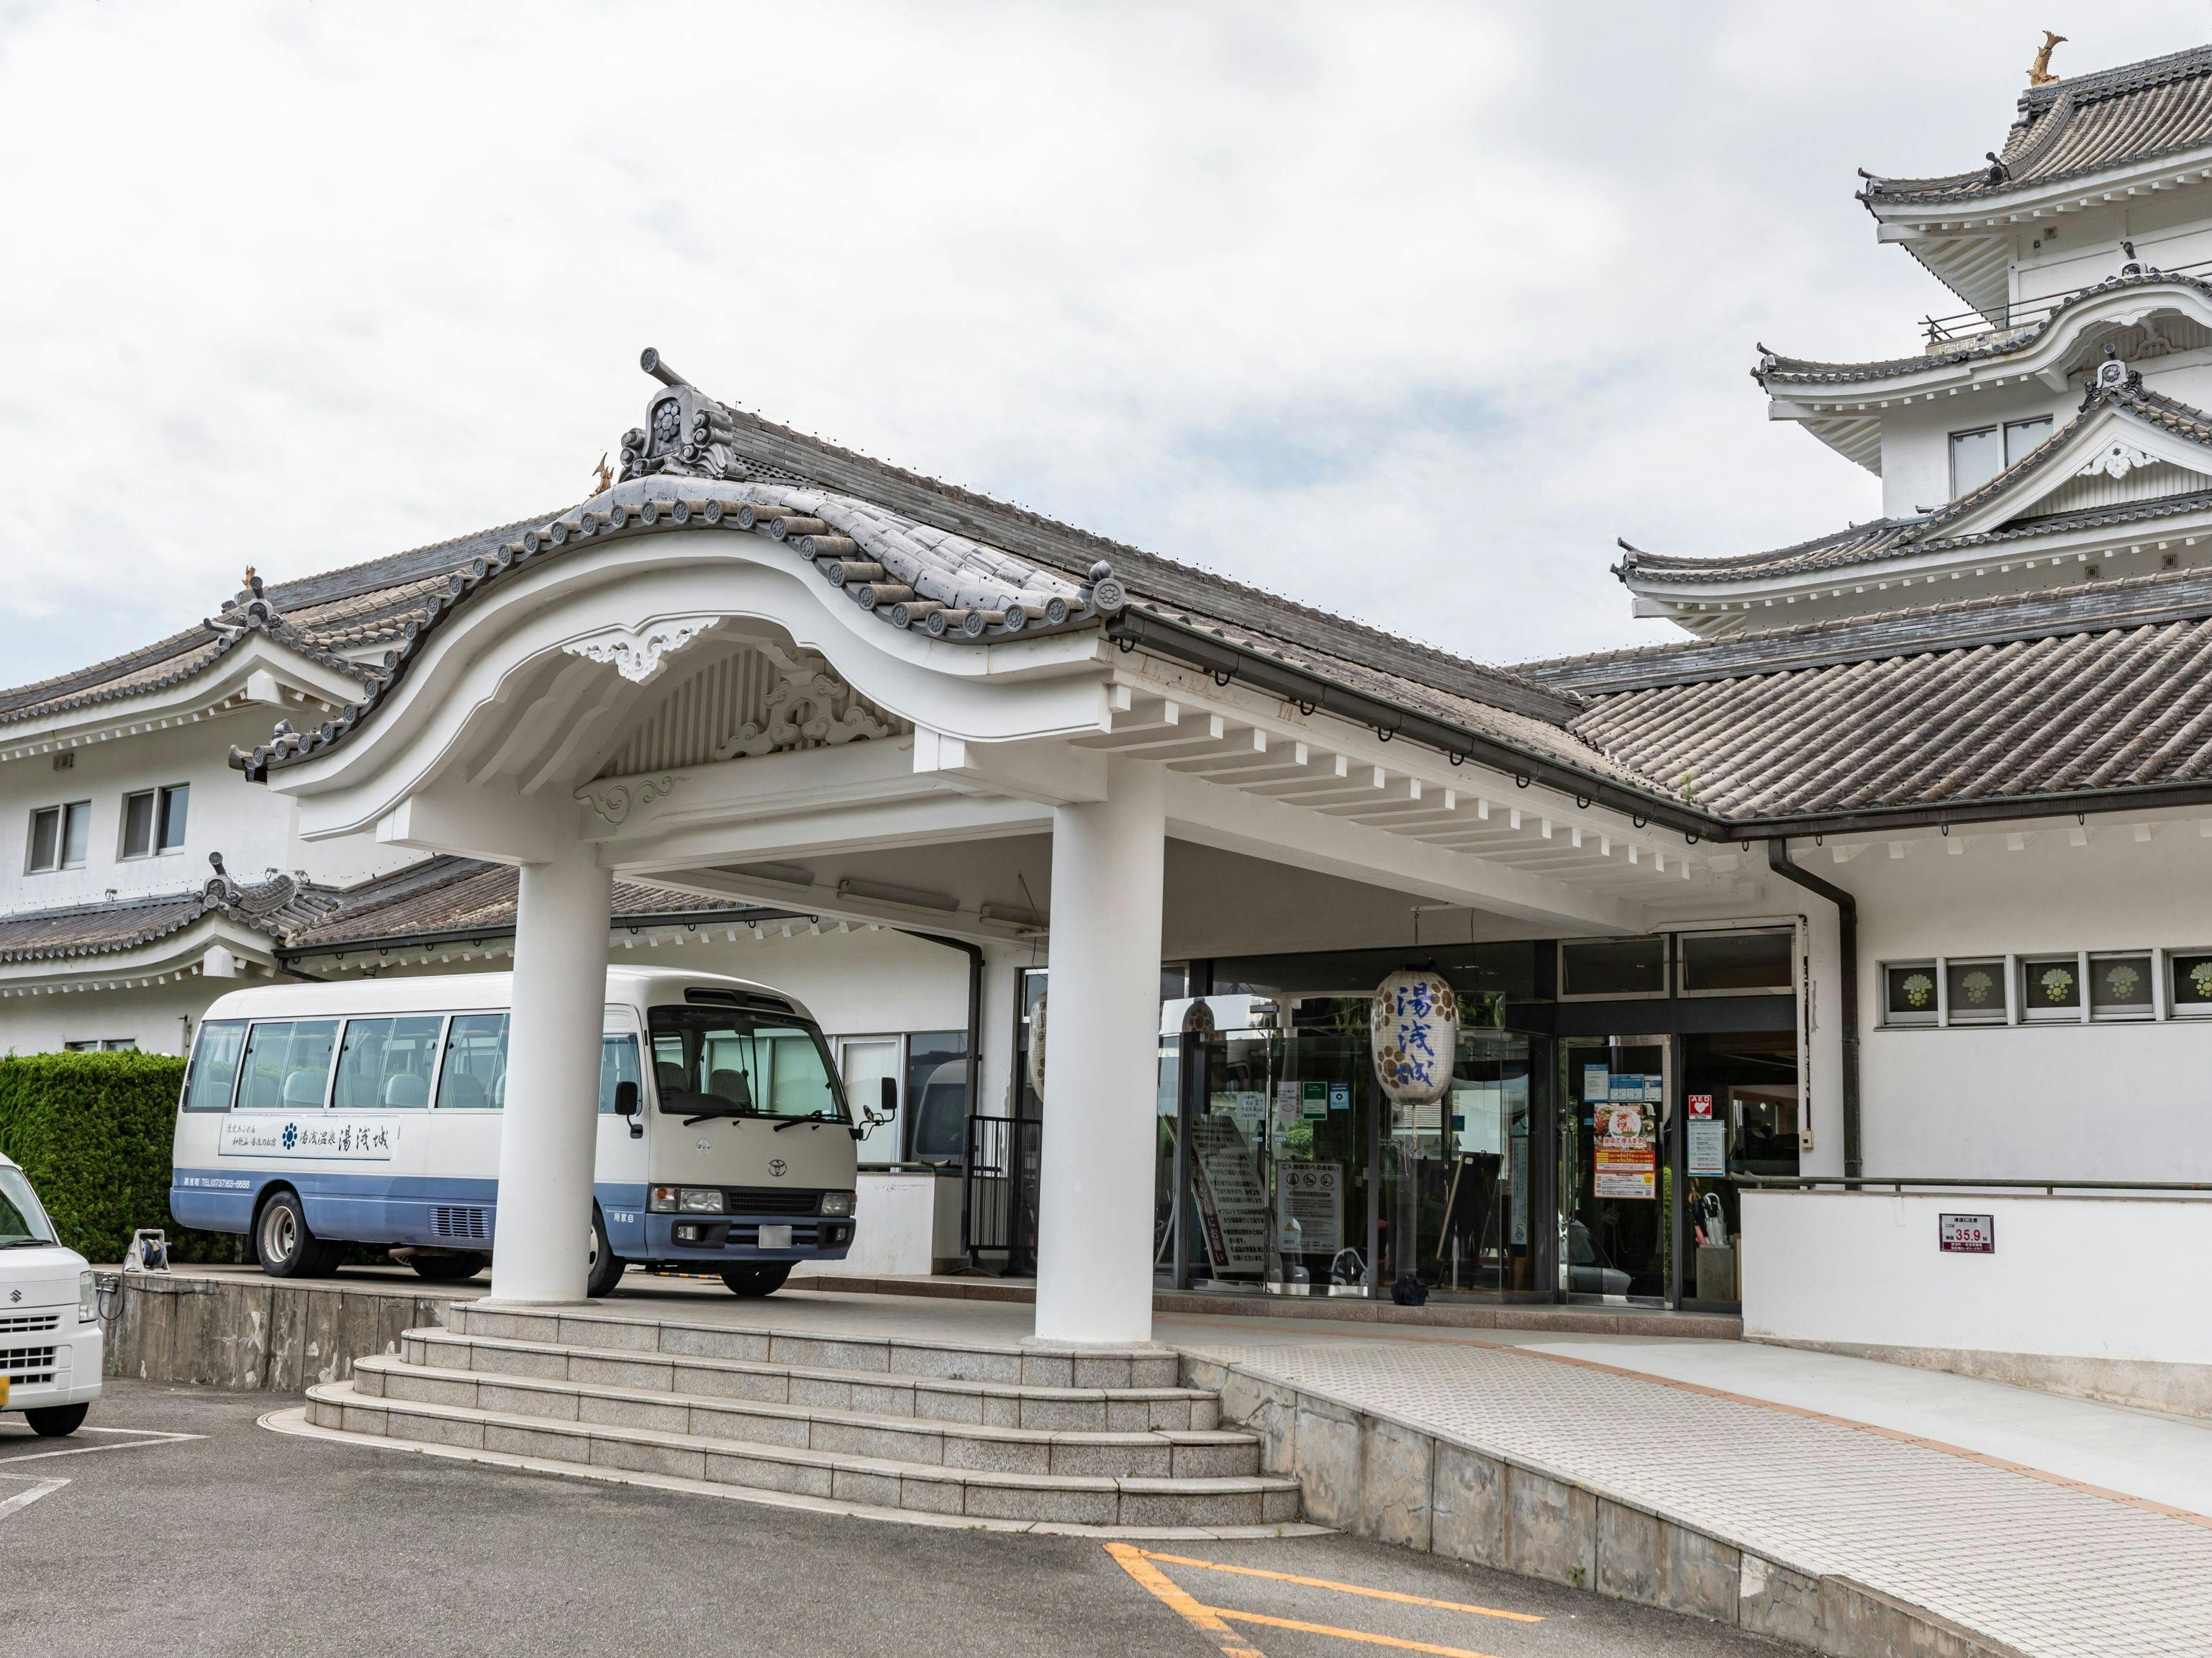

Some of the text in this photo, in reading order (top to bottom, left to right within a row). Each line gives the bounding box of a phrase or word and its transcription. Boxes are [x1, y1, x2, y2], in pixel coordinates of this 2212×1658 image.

[1393, 982, 1435, 1087] 湯浅城
[299, 1124, 389, 1151] 湯浅温泉 湯浅城
[1956, 1229, 1980, 1241] 35.9
